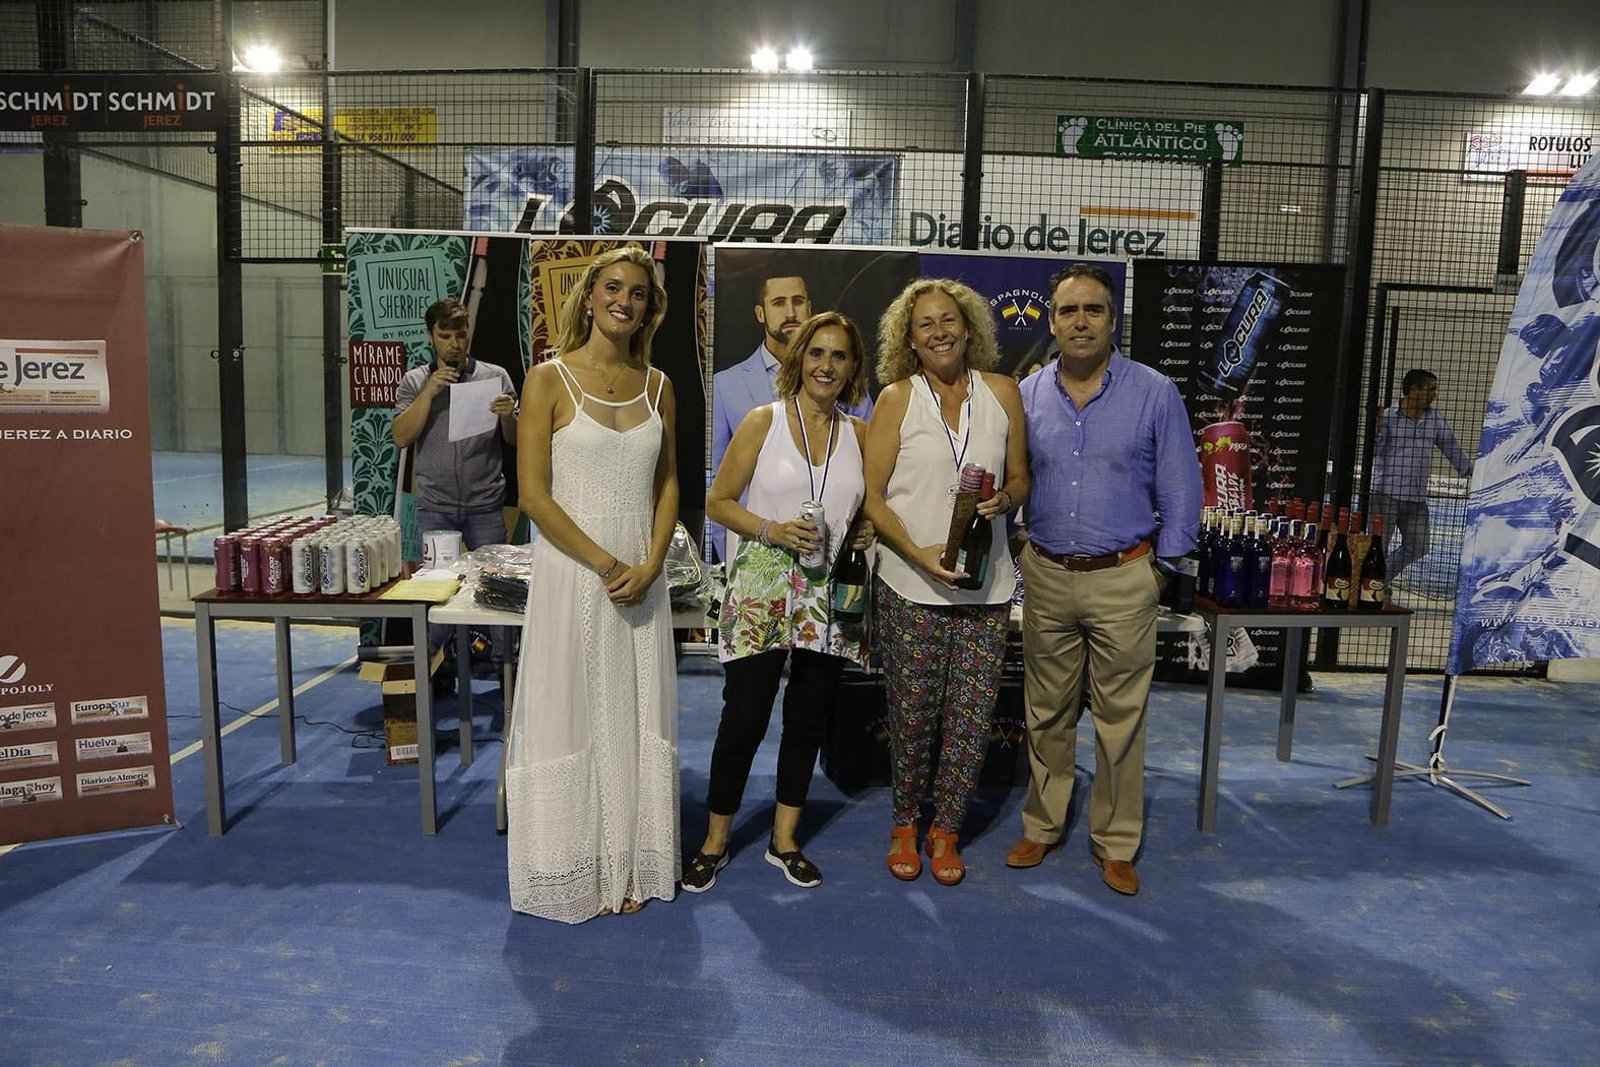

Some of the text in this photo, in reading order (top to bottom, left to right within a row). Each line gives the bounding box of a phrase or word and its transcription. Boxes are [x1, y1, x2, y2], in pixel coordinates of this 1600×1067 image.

[31, 115, 69, 128] JEREZ
[143, 115, 181, 128] JEREZ
[401, 132, 415, 141] 000
[1529, 136, 1591, 152] ROTULOS
[1570, 155, 1592, 168] LU
[910, 212, 1014, 251] Diaio
[1024, 213, 1069, 251] de
[378, 267, 431, 291] UNUSUAL
[379, 295, 431, 319] SHERRIES
[383, 329, 426, 339] BY ROMA
[1218, 288, 1268, 377] LOCURA
[353, 342, 402, 365] MÍRAME
[0, 355, 85, 387] e Jerez
[354, 366, 401, 385] CUANDO
[354, 386, 366, 401] TE
[56, 430, 67, 440] A
[73, 429, 133, 440] DIARIO
[1, 684, 54, 695] POJOLY
[23, 710, 48, 721] Jerez
[79, 738, 117, 749] Huelva
[81, 777, 106, 786] Diario
[0, 782, 55, 797] laga hoy
